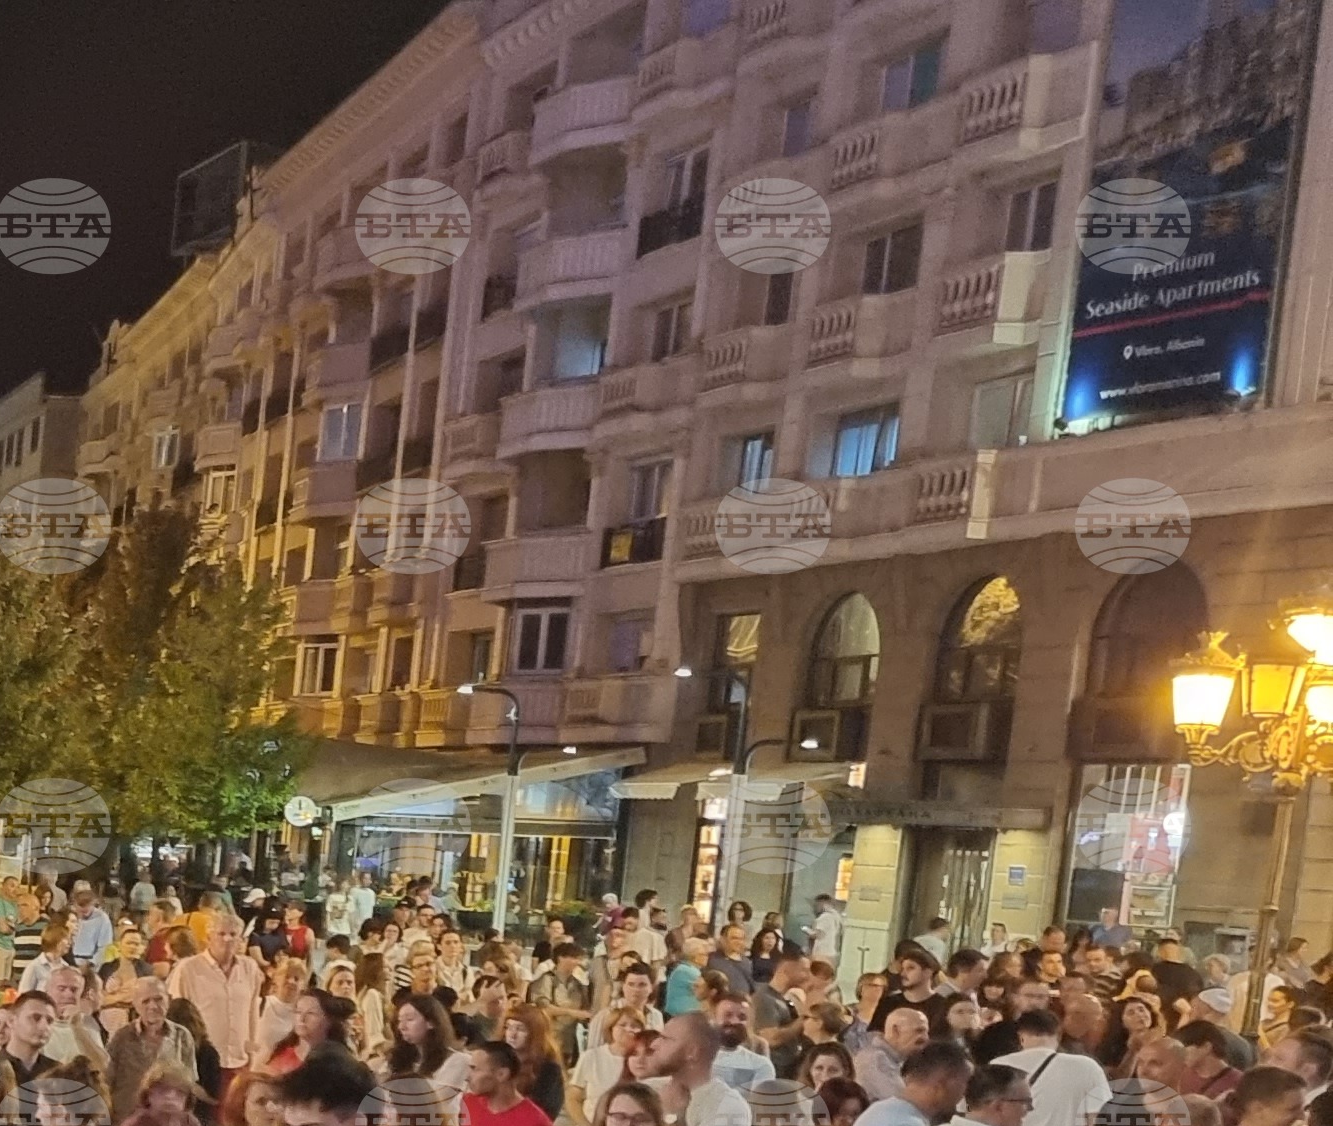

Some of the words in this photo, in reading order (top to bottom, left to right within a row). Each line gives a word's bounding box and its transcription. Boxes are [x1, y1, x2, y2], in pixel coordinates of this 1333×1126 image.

[1133, 251, 1215, 281] Premium
[1085, 290, 1151, 319] Seaside
[1155, 270, 1260, 308] Apartments
